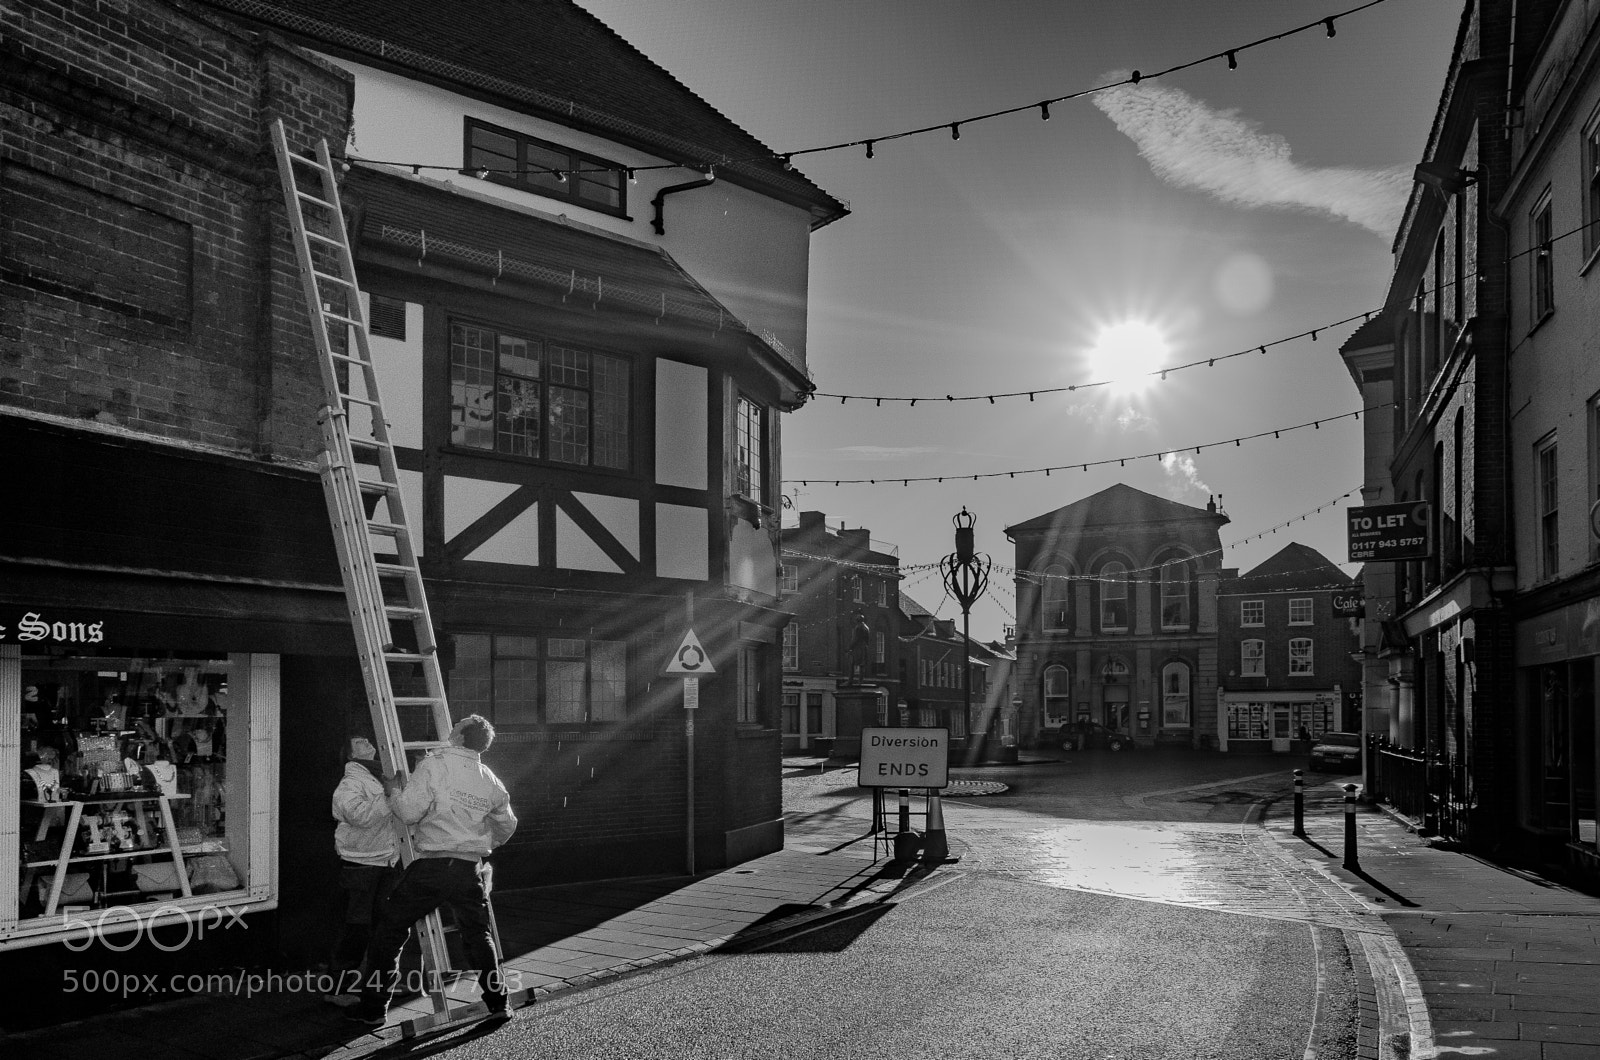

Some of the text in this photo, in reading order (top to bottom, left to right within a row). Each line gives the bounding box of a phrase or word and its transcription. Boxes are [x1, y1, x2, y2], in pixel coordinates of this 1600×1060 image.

[1351, 514, 1407, 530] TO LET
[1352, 537, 1425, 550] 0117 943 5757
[1350, 550, 1375, 559] CBRE
[17, 611, 104, 643] Sons
[871, 735, 938, 748] Diversion
[878, 762, 929, 777] ENDS
